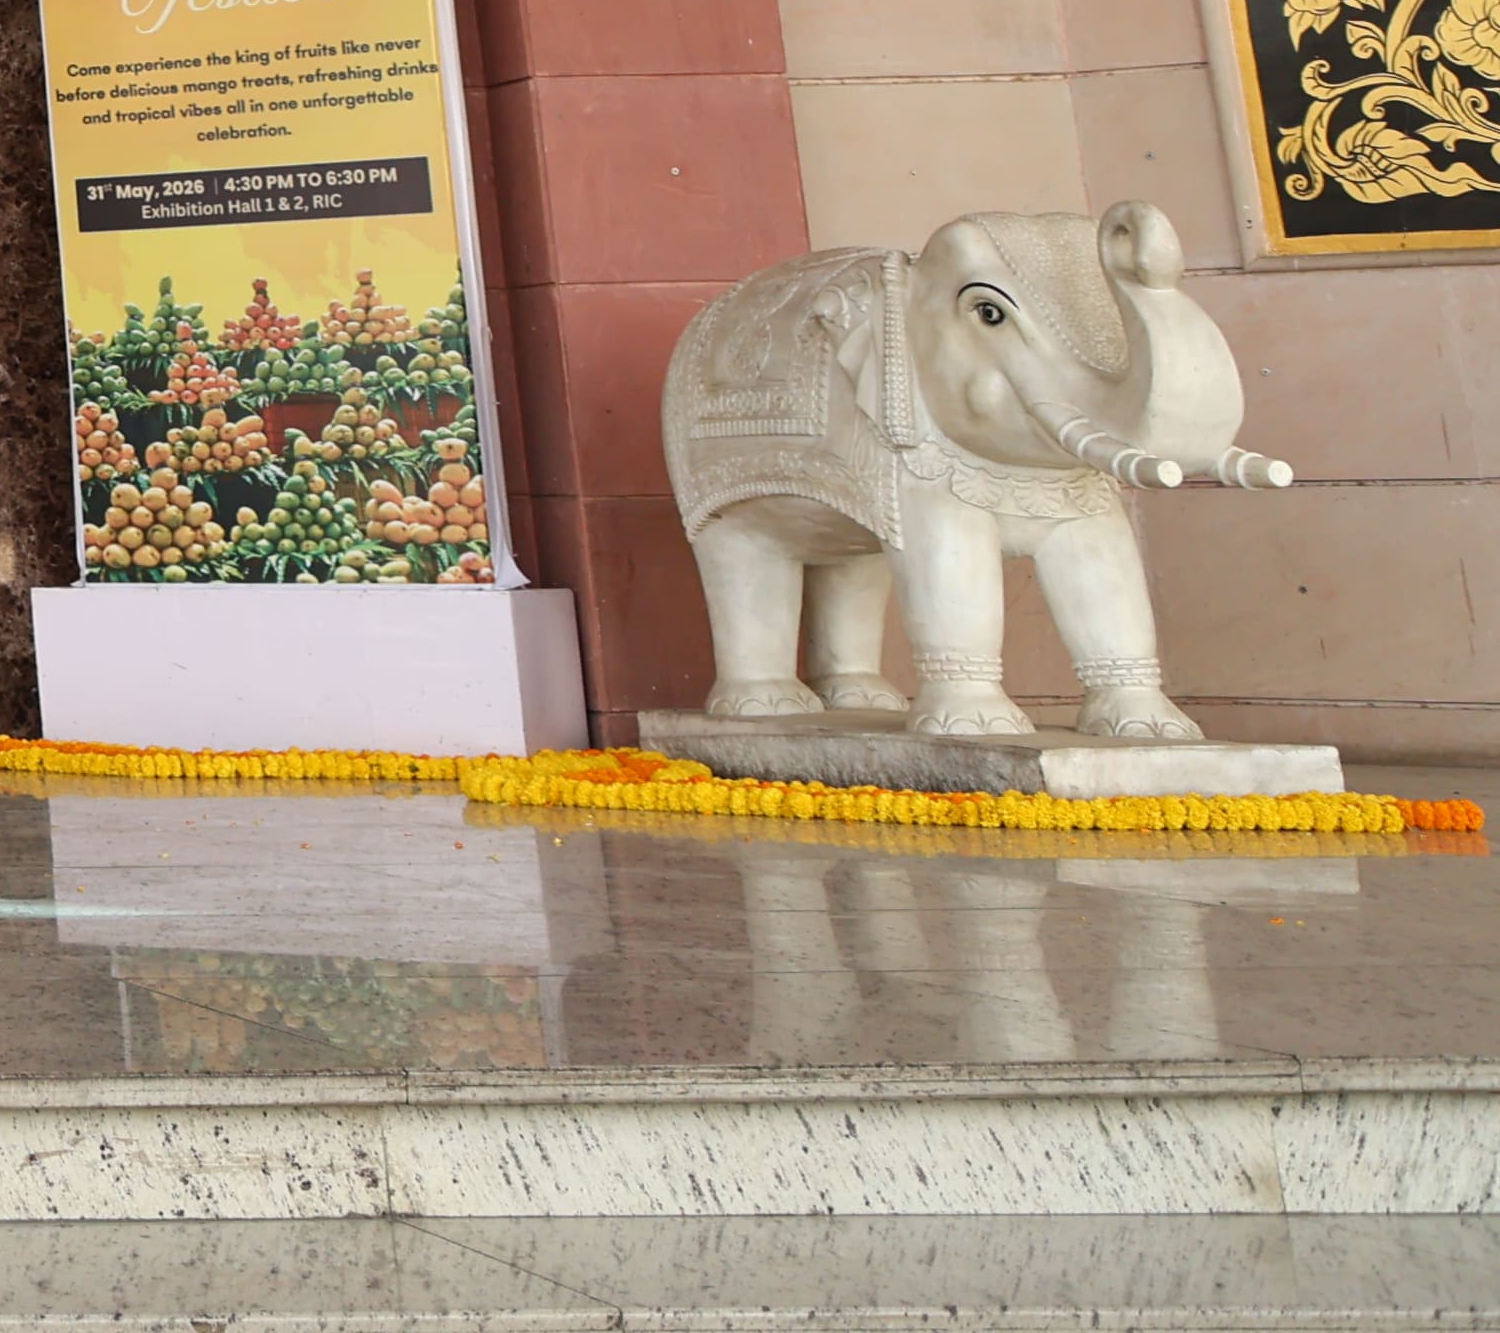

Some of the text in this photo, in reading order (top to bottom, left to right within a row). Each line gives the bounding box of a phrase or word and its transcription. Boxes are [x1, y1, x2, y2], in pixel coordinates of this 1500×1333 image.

[67, 37, 422, 78] Come experience the king of fruits like never
[56, 60, 439, 103] before delicious mango treats, refreshing drinks
[82, 88, 414, 125] and tropical vibes all in one unforgettable
[197, 124, 292, 142] celebration.
[116, 181, 160, 202] May,
[163, 179, 204, 197] 2026
[224, 175, 263, 193] 4:30
[266, 173, 293, 190] PM
[297, 172, 323, 188] TO
[326, 170, 365, 188] 6:30
[369, 167, 397, 185] PM
[141, 194, 343, 220] Exhibition Hall 1 & 2, RIC
